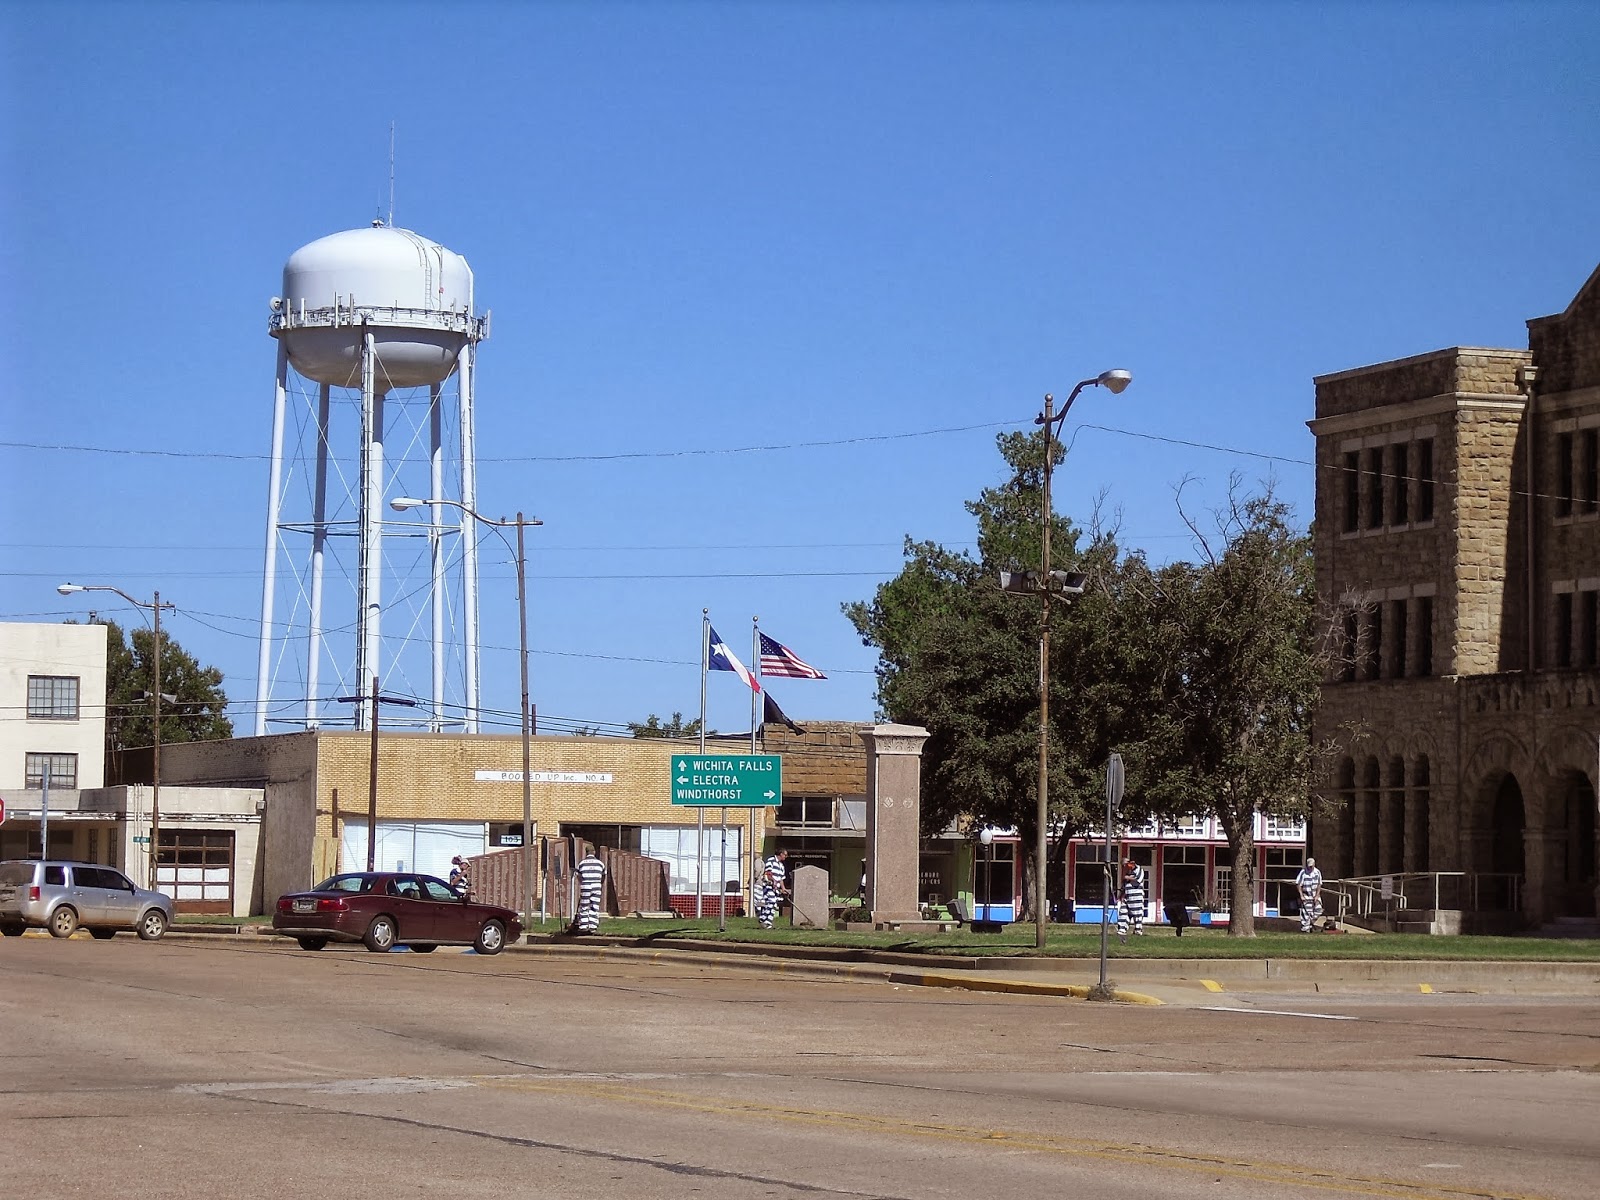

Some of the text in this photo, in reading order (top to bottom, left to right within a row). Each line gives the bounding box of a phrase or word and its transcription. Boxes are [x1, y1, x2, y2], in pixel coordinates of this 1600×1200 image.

[693, 760, 773, 771] WICHITA FALLS
[501, 772, 541, 780] BOOED
[547, 773, 560, 781] UP
[693, 775, 739, 785] ELECTRA
[676, 789, 742, 800] WINDTHORST
